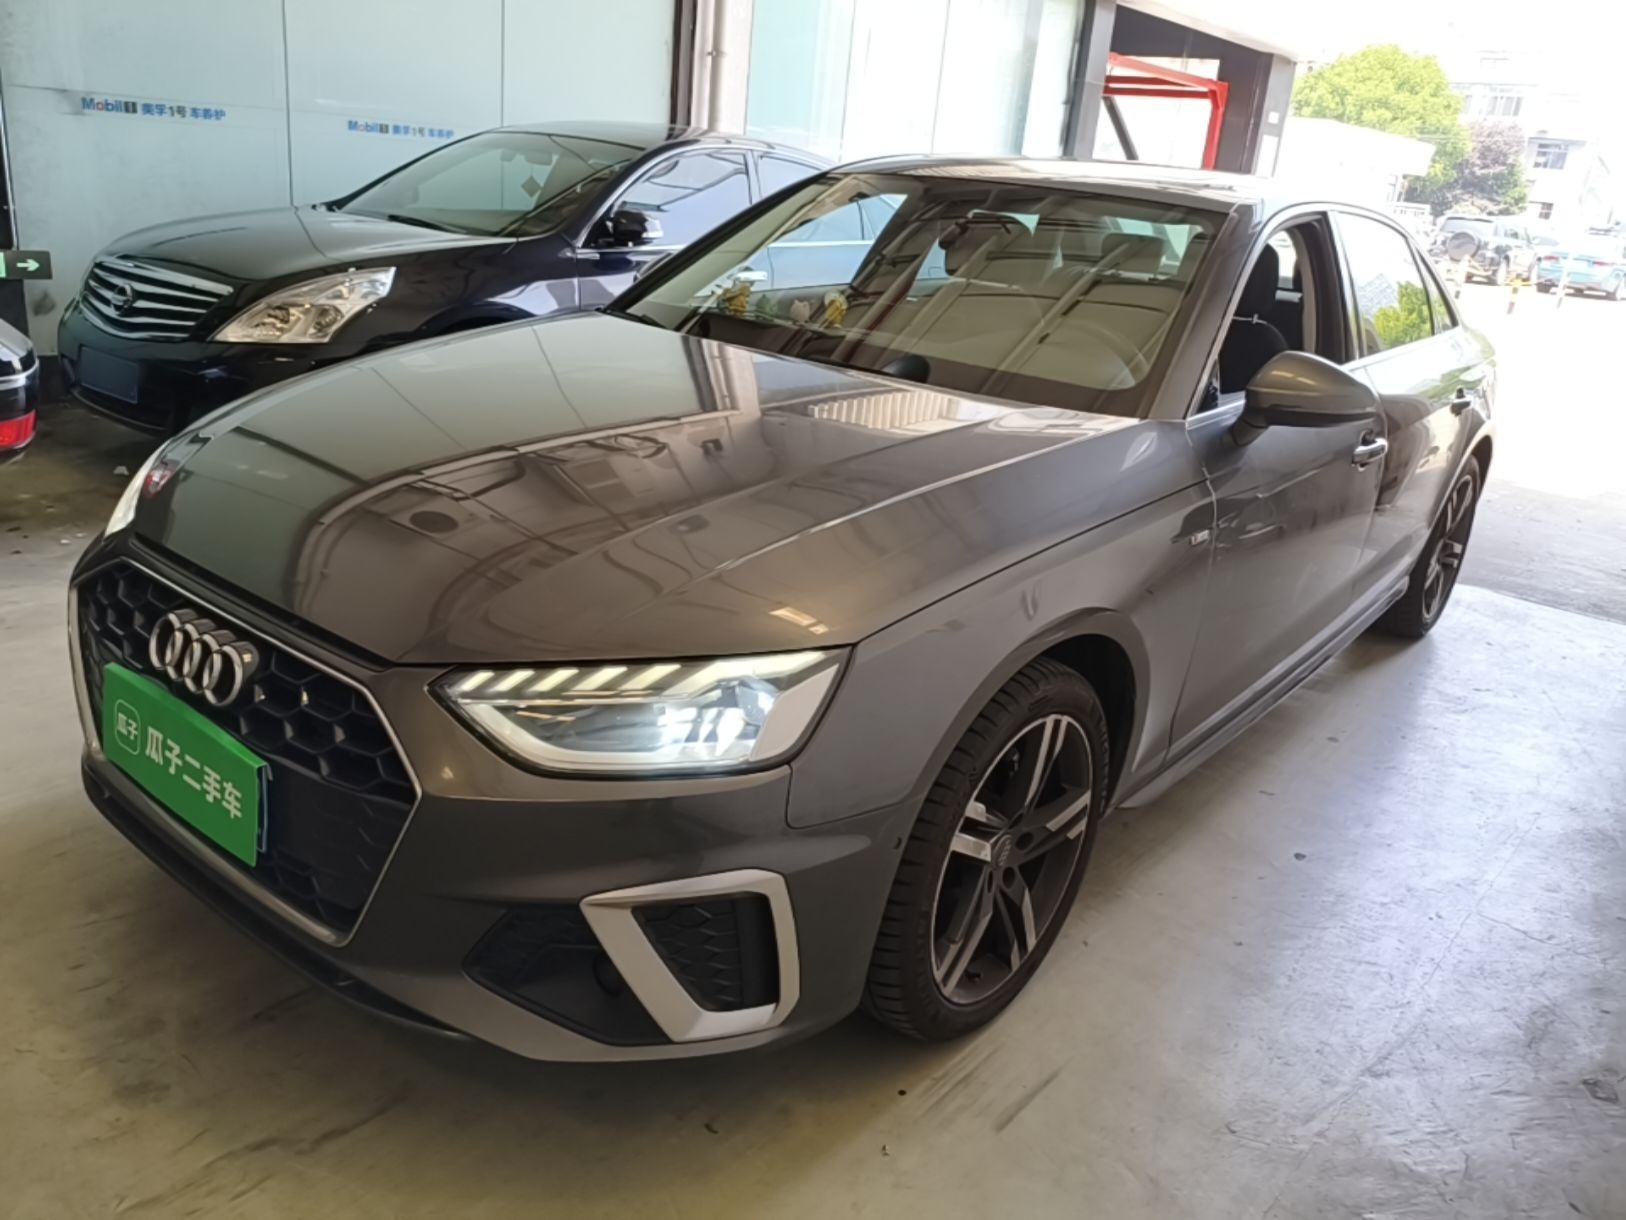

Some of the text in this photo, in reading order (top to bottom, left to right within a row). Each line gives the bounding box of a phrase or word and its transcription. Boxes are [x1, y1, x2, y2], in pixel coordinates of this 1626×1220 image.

[115, 711, 138, 741] 瓜子
[145, 726, 242, 819] 瓜子二手车
